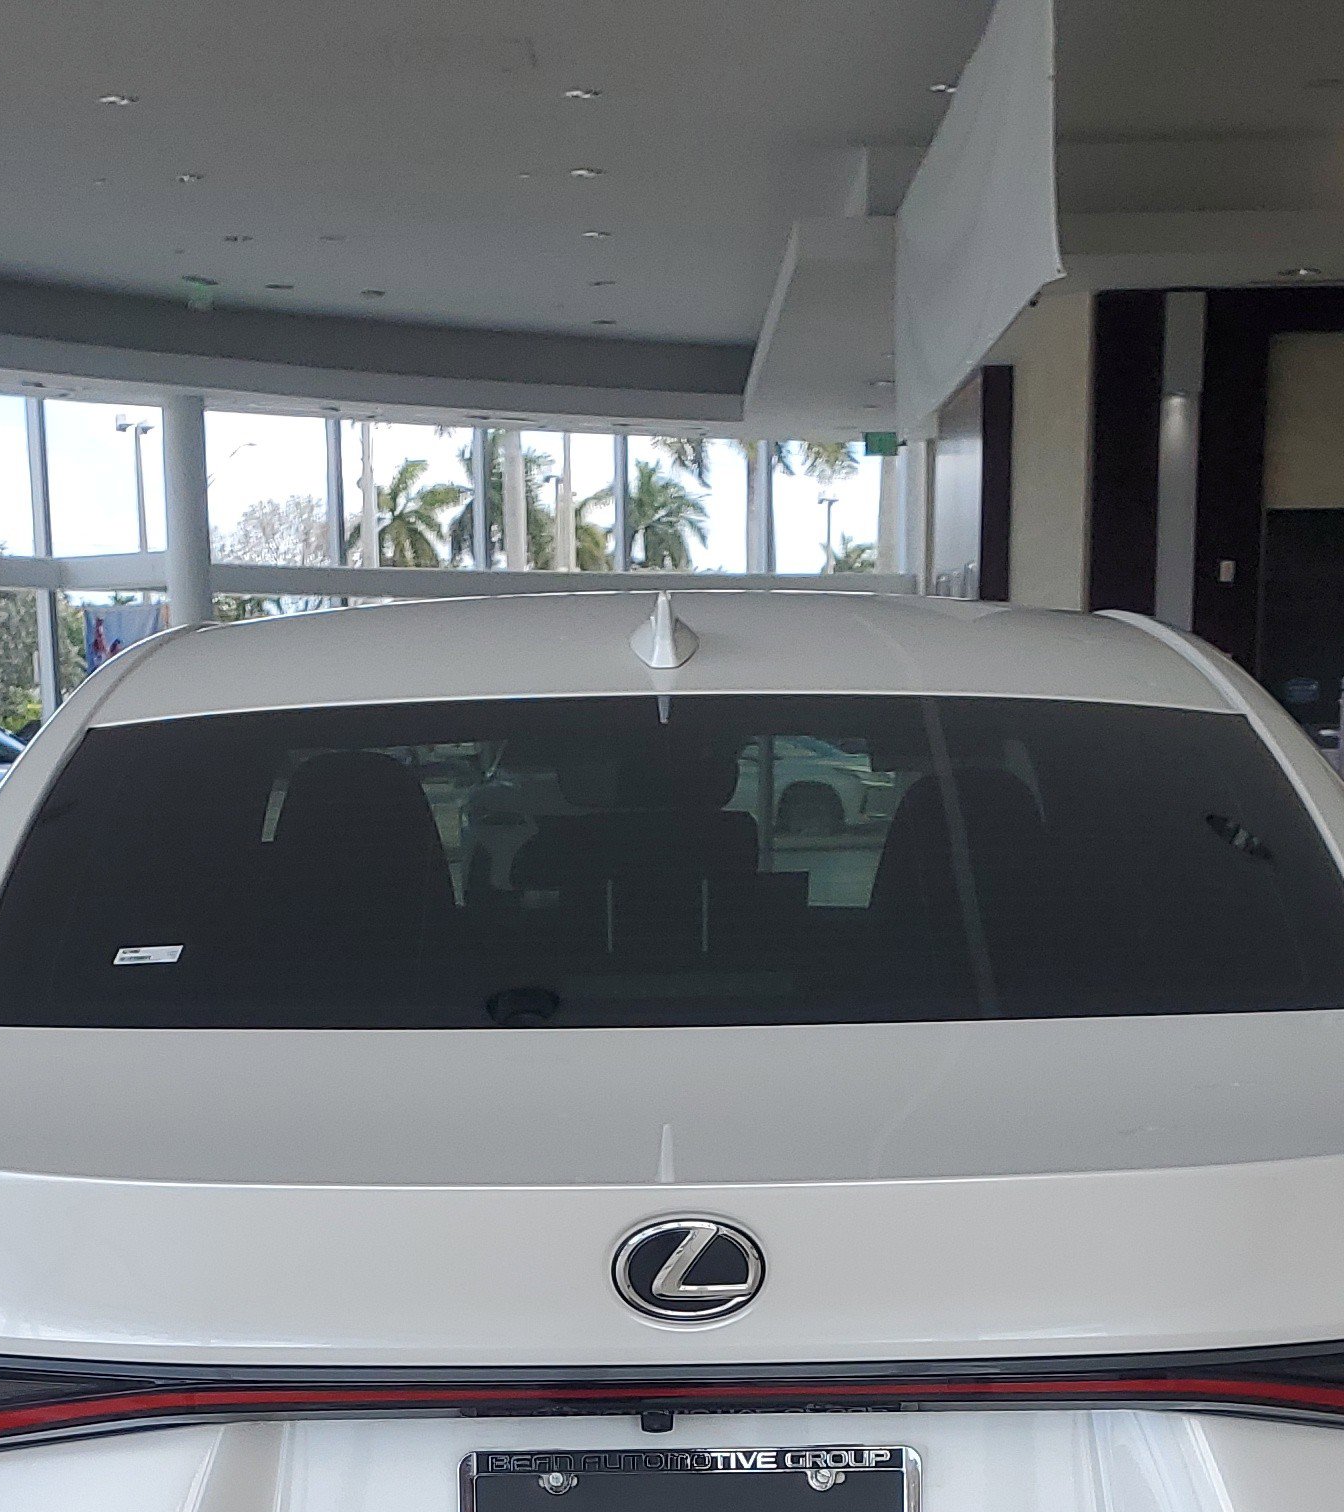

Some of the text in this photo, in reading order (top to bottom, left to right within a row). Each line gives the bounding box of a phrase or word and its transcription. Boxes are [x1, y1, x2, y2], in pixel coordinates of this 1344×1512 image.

[488, 1449, 891, 1472] BEAN AUTOMOTIVE GROUP
